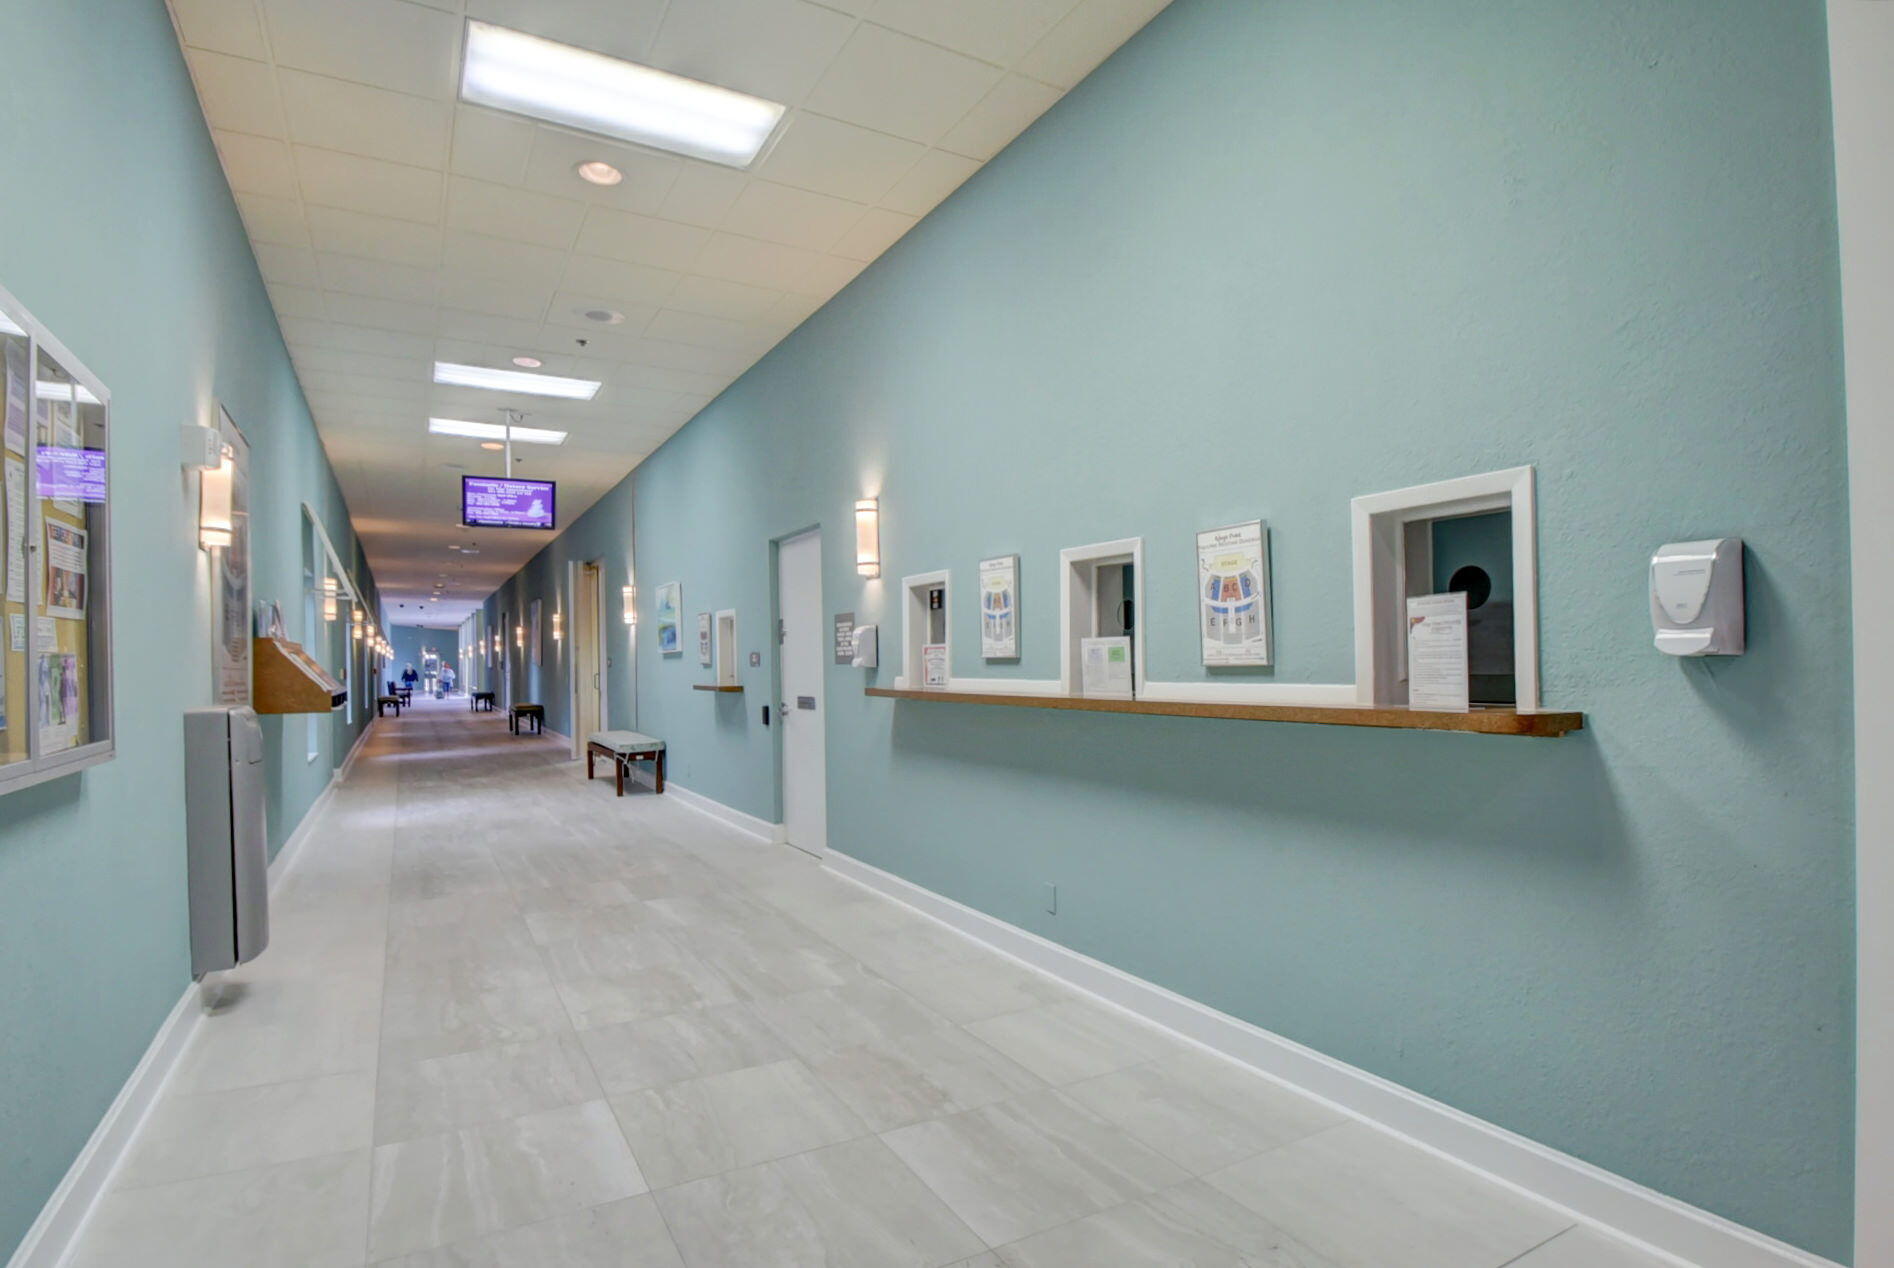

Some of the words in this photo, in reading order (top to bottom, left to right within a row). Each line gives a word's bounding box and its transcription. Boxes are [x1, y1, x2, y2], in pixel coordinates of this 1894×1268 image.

[1223, 584, 1230, 593] B
[1232, 583, 1238, 592] C
[1245, 578, 1252, 588] D
[1210, 618, 1216, 626] E
[1236, 618, 1242, 627] G
[1249, 615, 1255, 624] H
